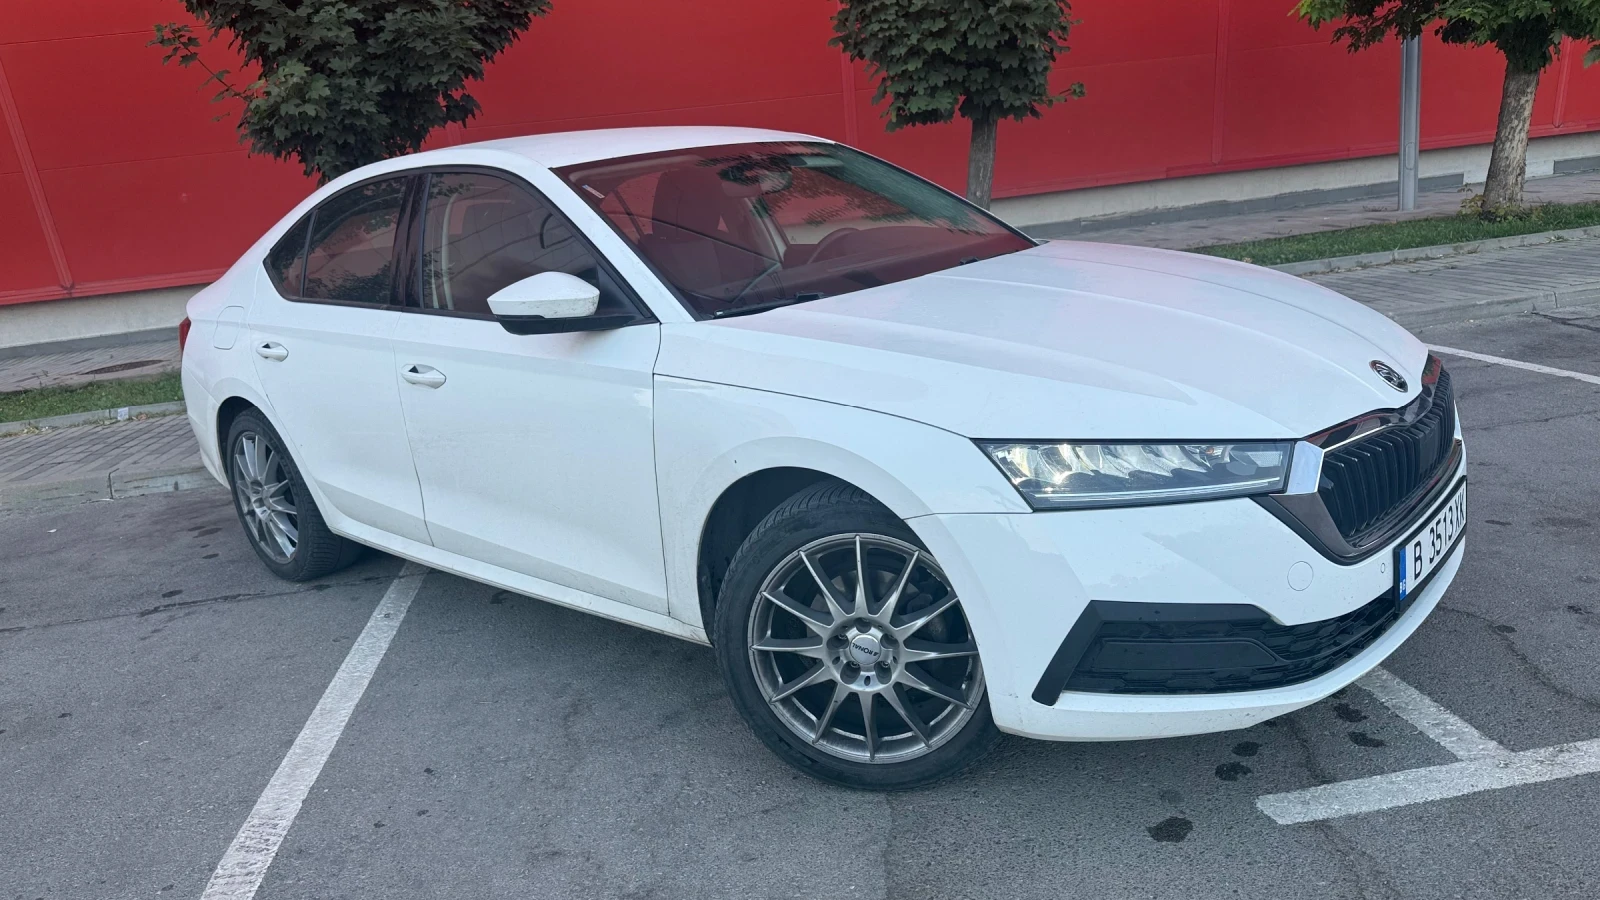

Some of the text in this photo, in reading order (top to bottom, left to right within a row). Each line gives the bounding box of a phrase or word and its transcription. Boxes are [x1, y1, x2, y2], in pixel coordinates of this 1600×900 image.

[1413, 488, 1465, 581] B 3513 XK
[852, 642, 874, 655] RONAL
